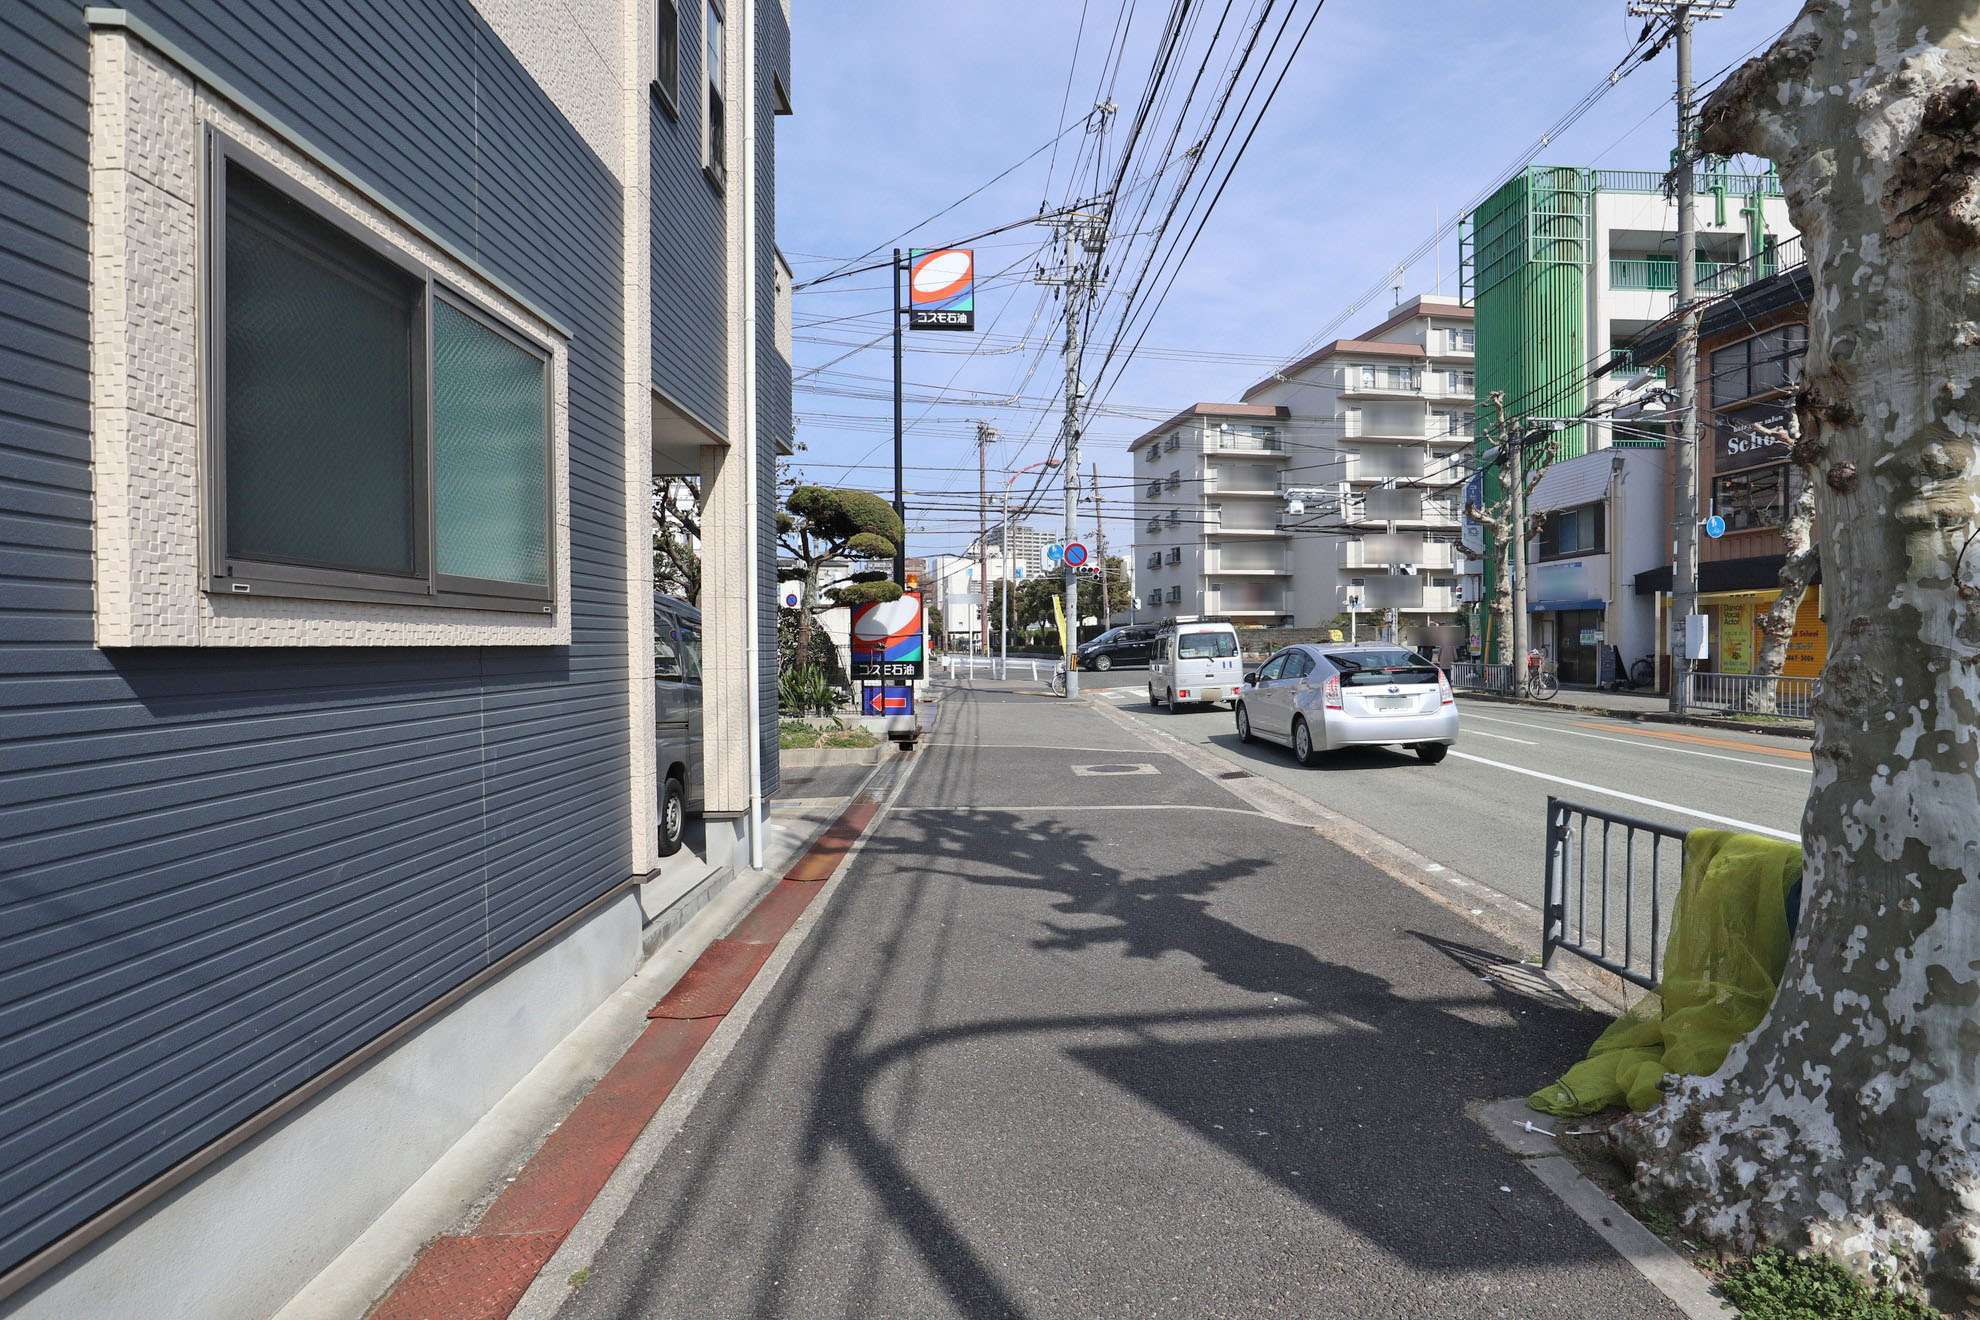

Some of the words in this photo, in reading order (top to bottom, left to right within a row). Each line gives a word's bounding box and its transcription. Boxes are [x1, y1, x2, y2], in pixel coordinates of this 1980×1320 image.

[917, 312, 967, 323] コスモ石油
[859, 664, 914, 675] コスモ石油
